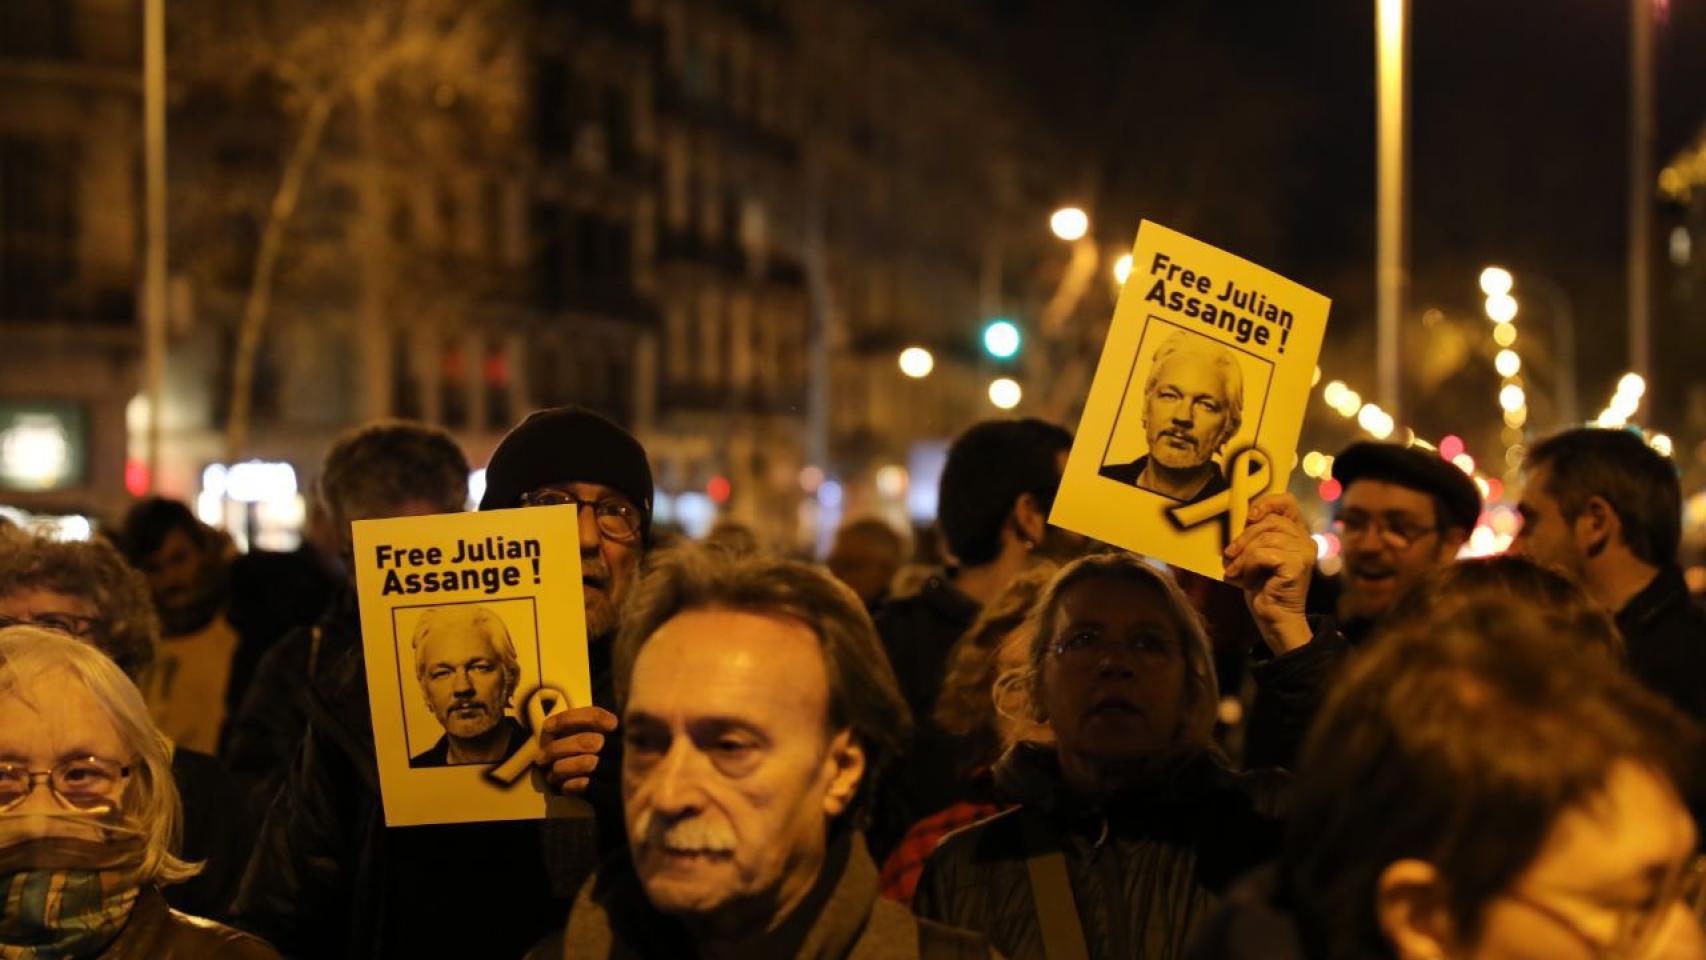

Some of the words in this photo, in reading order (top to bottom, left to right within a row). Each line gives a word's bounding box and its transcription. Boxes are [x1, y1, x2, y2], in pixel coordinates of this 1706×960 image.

[1144, 278, 1270, 346] Assange
[1278, 329, 1289, 354] !
[1150, 252, 1212, 294] Free
[1216, 280, 1294, 330] Julian
[375, 544, 442, 569] Free
[451, 535, 541, 563] Julian
[382, 565, 521, 596] Assange
[531, 558, 541, 584] !
